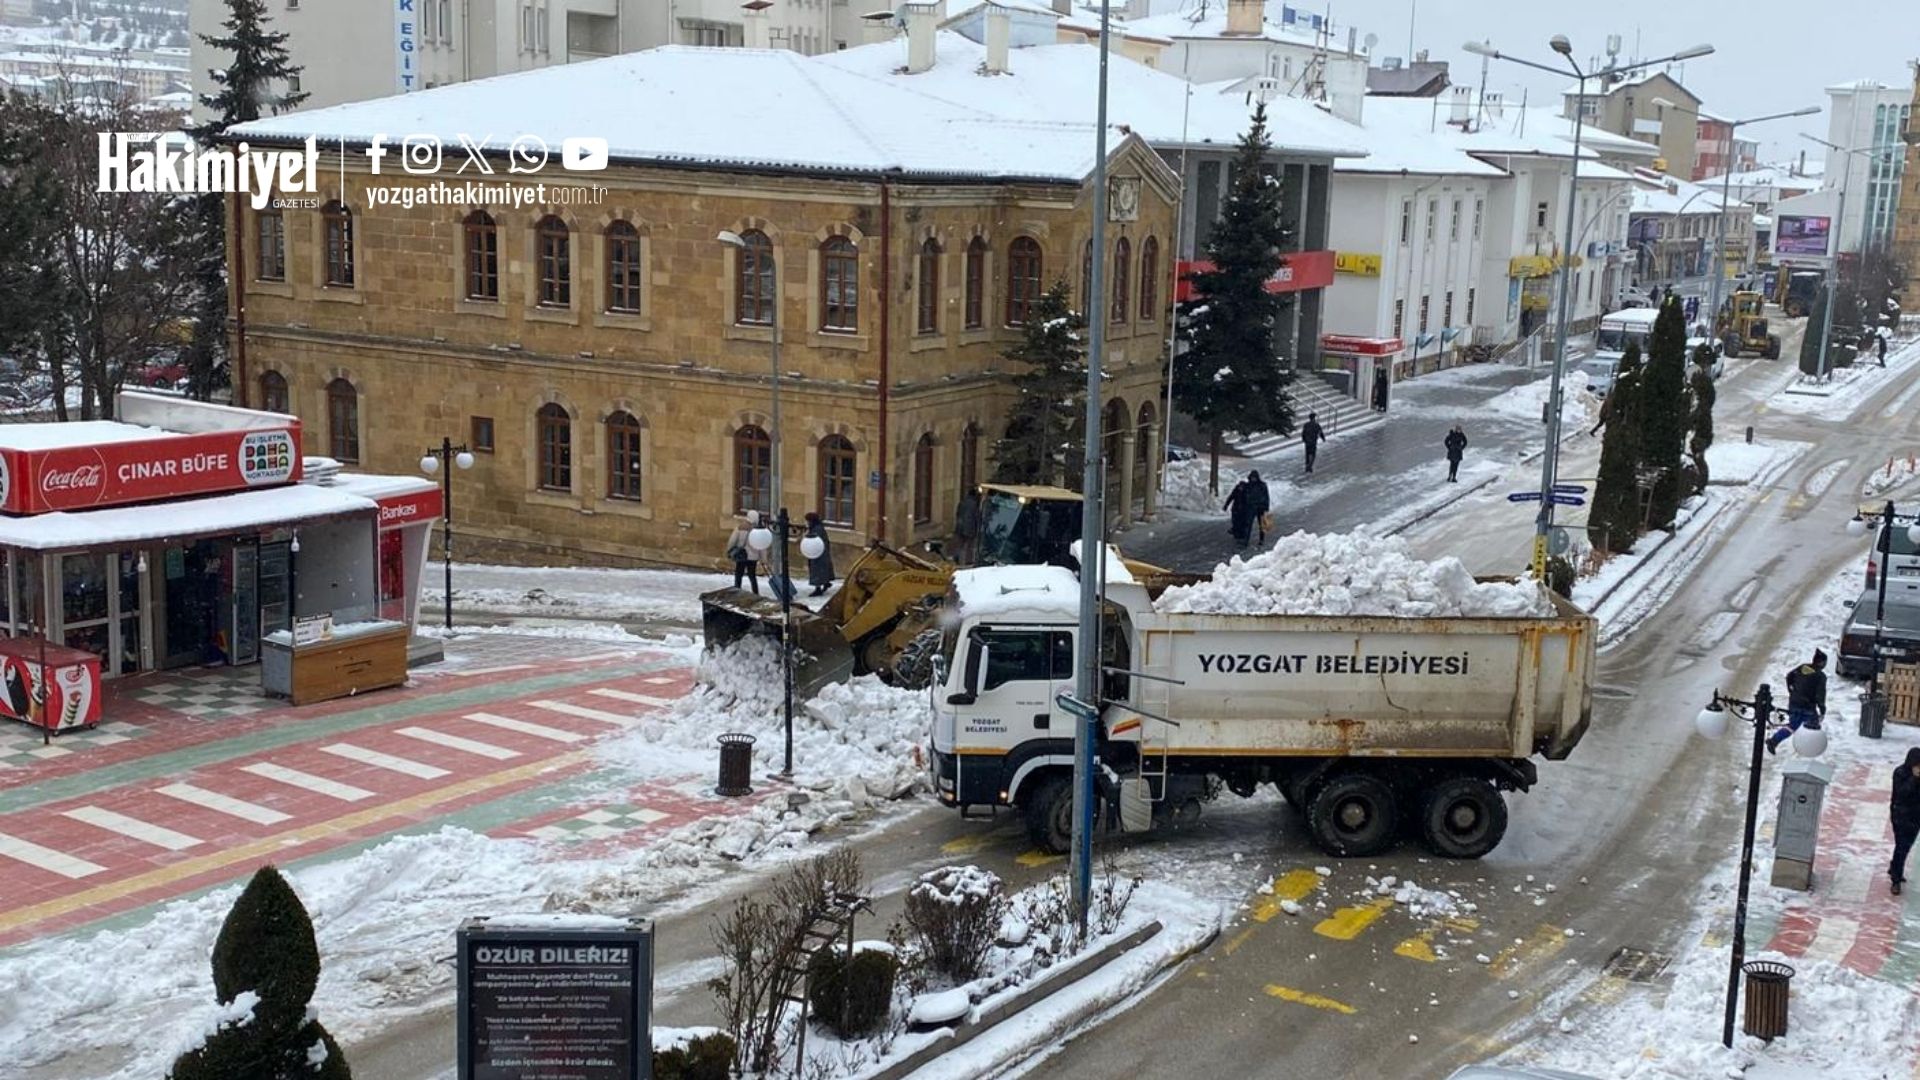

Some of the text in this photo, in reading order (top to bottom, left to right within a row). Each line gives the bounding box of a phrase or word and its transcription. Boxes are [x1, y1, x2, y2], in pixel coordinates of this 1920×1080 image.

[400, 22, 414, 93] EĞİT
[118, 454, 228, 483] ÇINAR BÜFE
[382, 504, 416, 519] Bankası
[1198, 651, 1469, 674] YOZGAT BELEDİYESİ
[965, 725, 1007, 733] BELEDİYESİ
[476, 946, 535, 963] ÖZÜR
